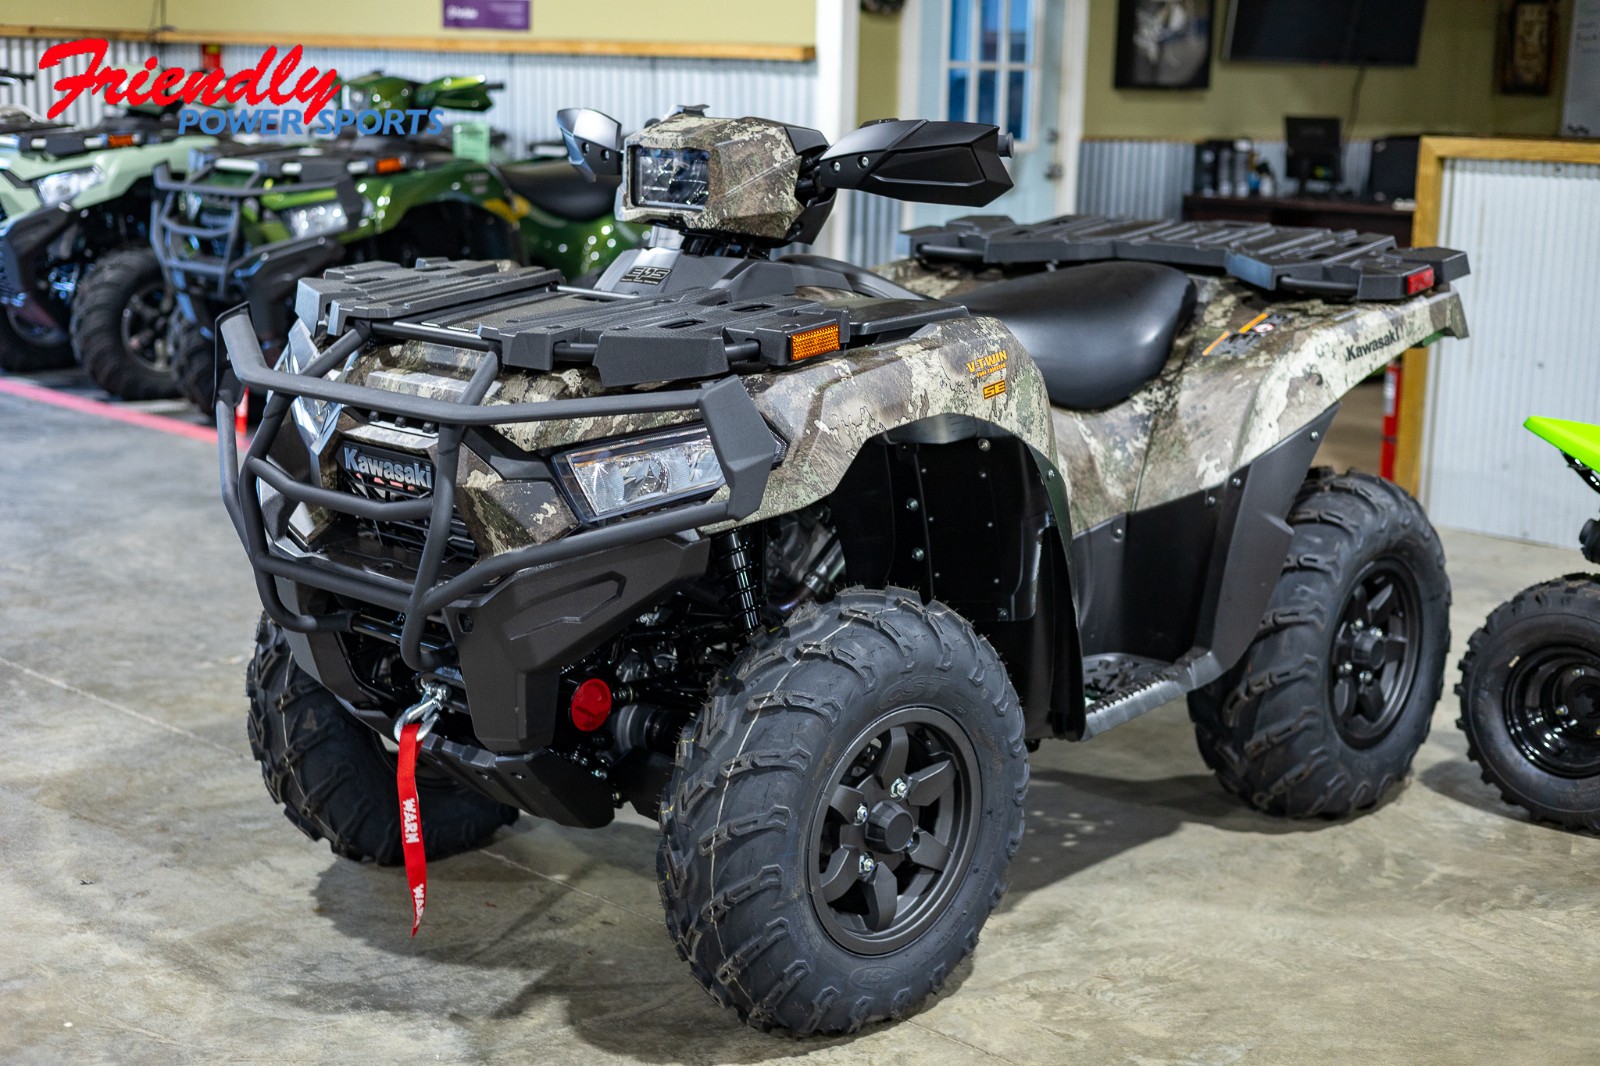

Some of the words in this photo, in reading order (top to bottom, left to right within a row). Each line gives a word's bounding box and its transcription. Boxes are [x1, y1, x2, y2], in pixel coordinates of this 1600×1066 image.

[625, 267, 671, 280] EPS
[1346, 327, 1399, 361] Kawasaki
[967, 350, 1007, 373] V-TWIN
[983, 381, 1005, 399] SE
[343, 447, 432, 489] Kawasaki
[403, 798, 419, 843] WARN
